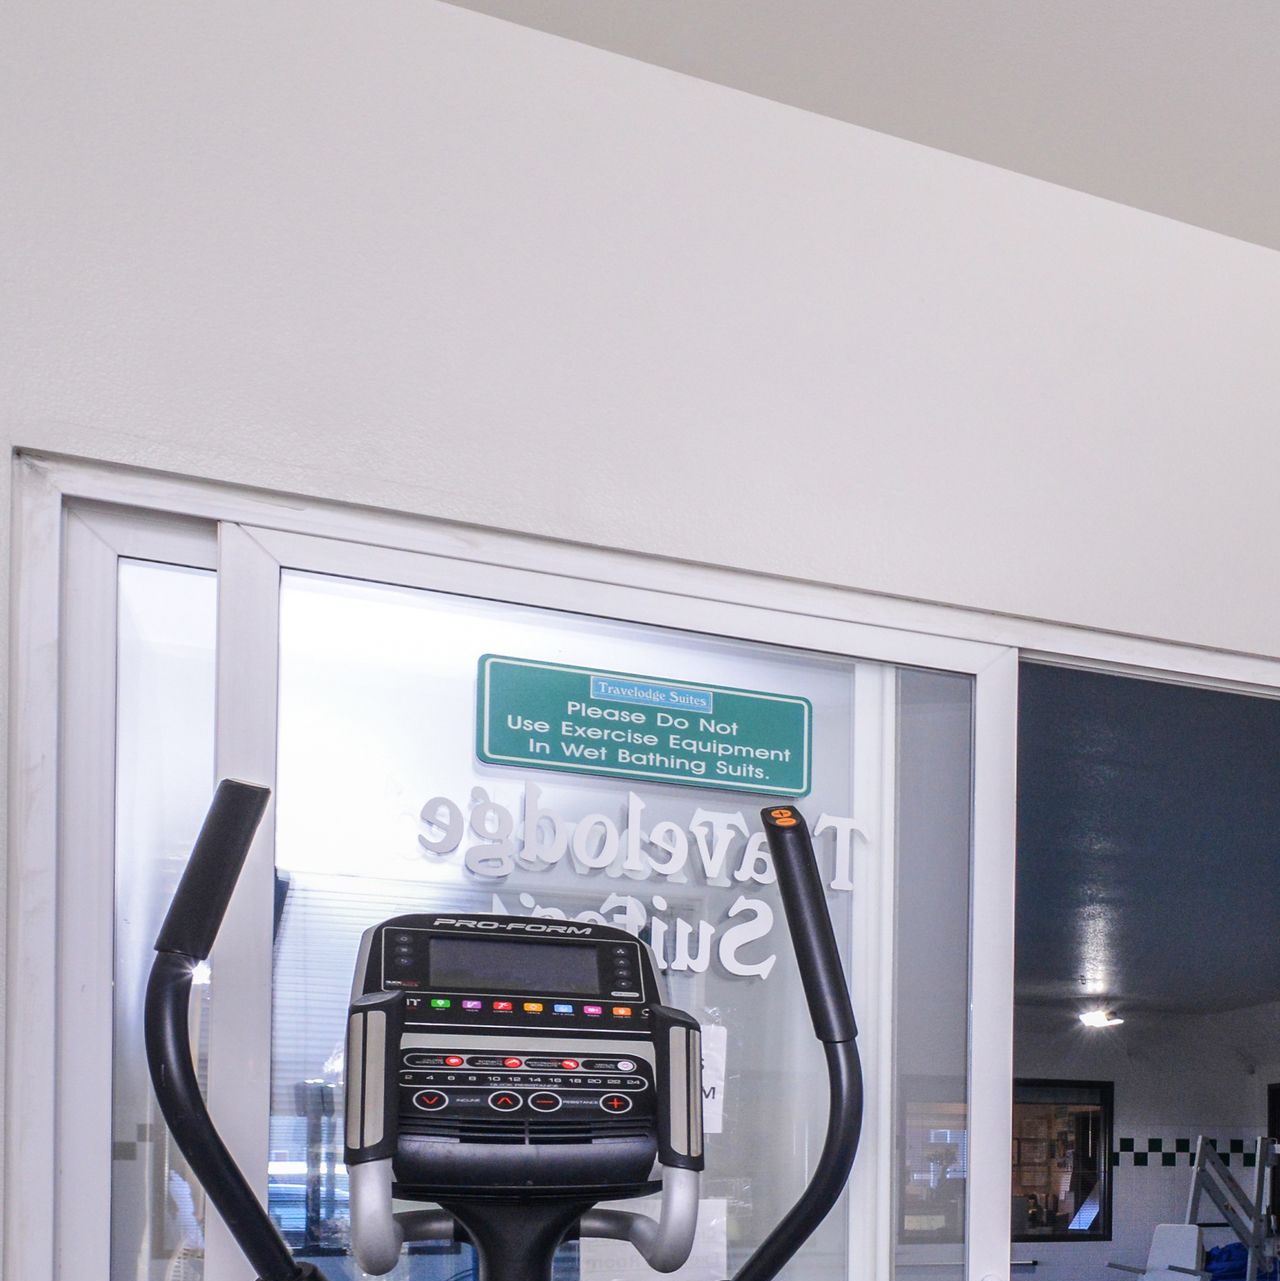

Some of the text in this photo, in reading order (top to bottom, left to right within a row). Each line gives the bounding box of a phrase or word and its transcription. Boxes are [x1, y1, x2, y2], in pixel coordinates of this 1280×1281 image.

[598, 681, 706, 706] Travelodge Suites
[567, 701, 739, 735] Please Do Not
[507, 714, 791, 762] Use Exercise Equipment
[529, 738, 770, 780] In Wet Bathing Suits.
[433, 918, 593, 936] PRO-FORM
